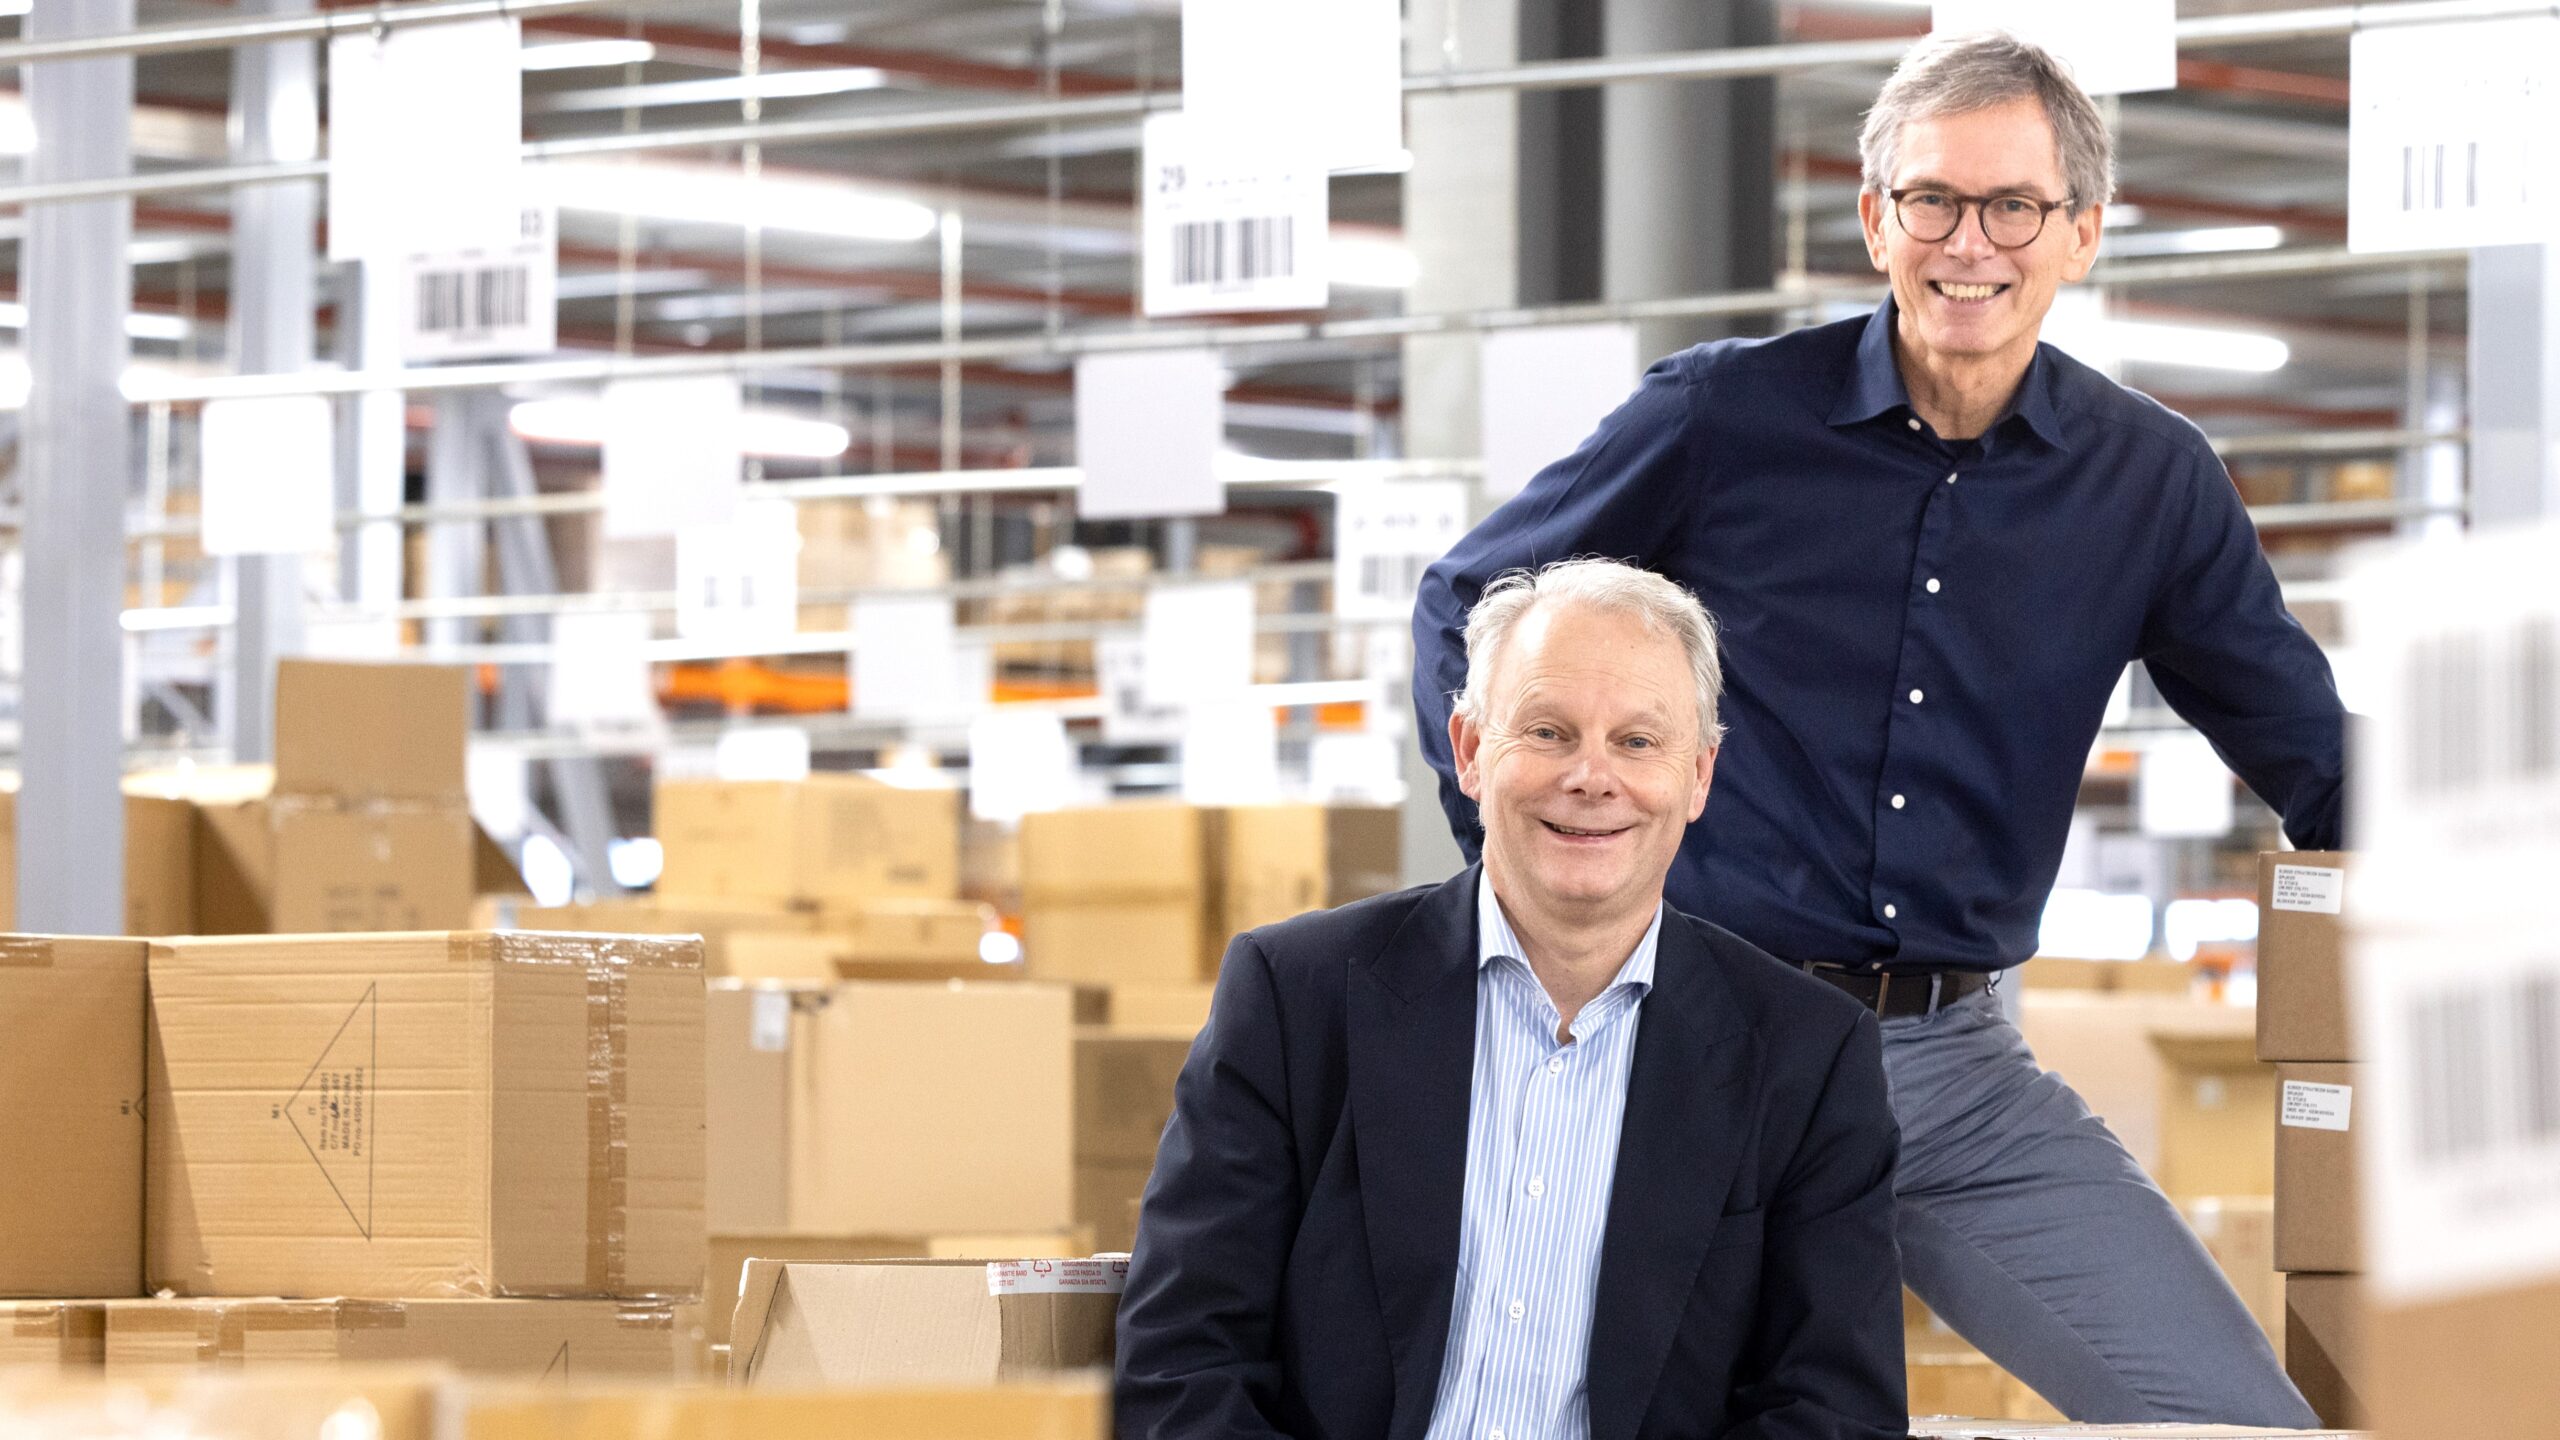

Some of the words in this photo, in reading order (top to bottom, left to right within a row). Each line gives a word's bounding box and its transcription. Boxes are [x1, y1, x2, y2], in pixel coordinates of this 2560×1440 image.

[343, 1073, 351, 1105] CHINA
[342, 1108, 350, 1119] IN
[342, 1120, 350, 1150] MADE
